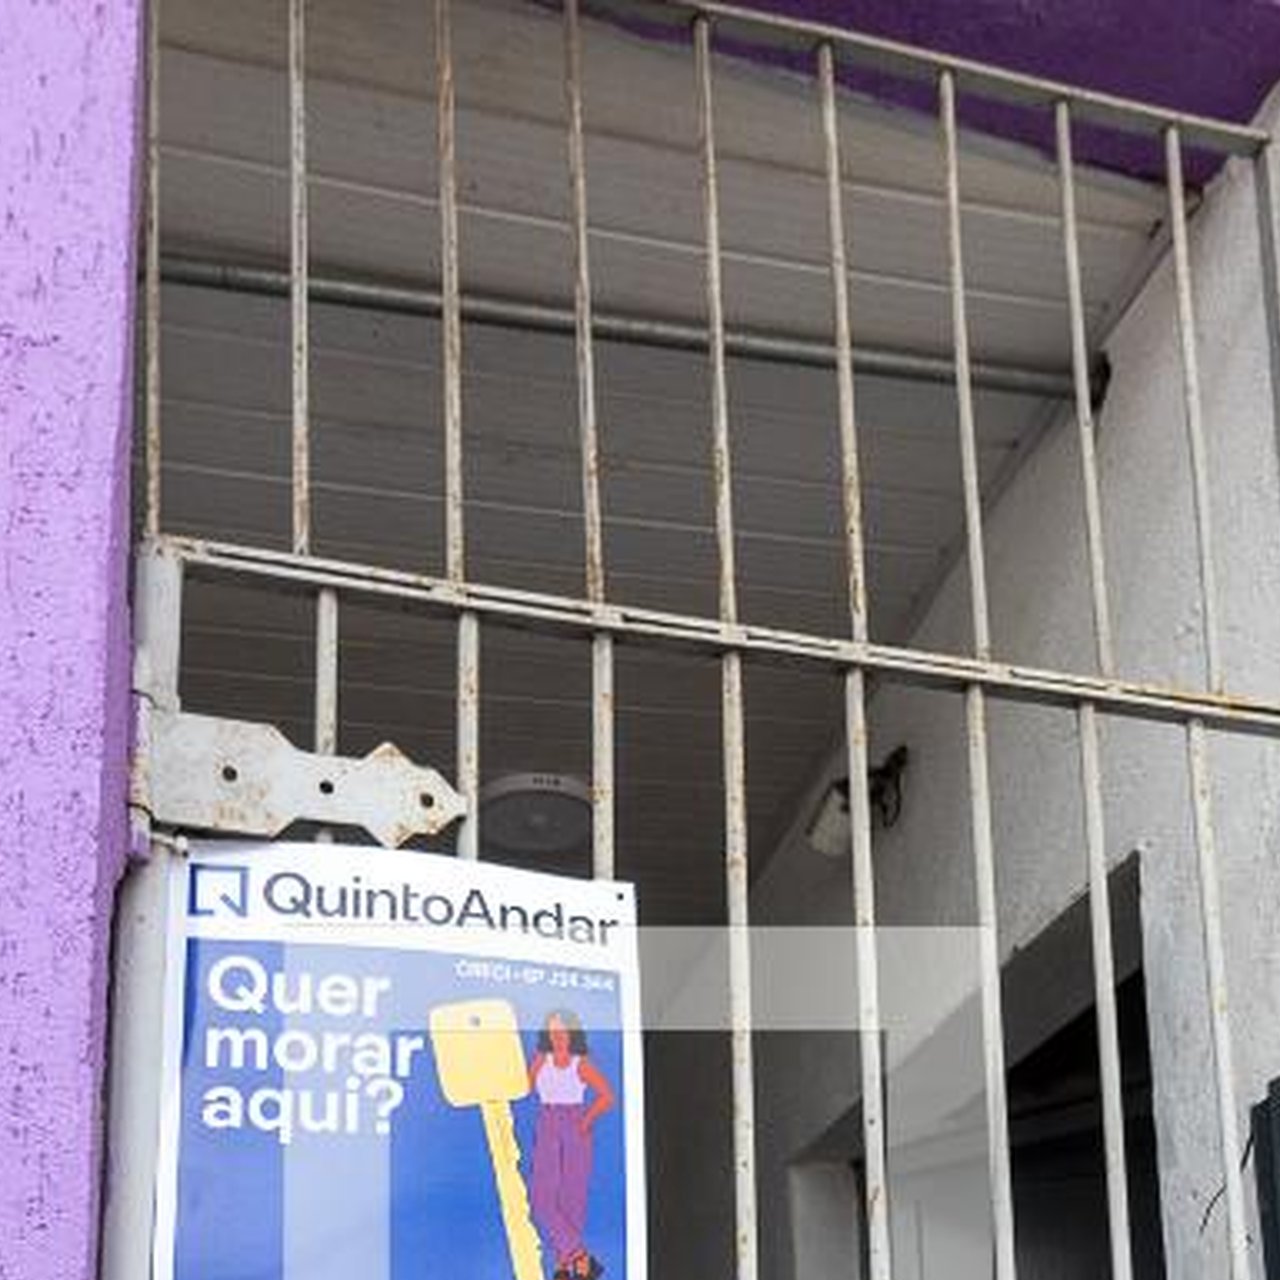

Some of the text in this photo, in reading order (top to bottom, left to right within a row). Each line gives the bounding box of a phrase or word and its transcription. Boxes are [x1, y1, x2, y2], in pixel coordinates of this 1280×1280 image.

[262, 870, 619, 947] QuintoAndar
[207, 955, 392, 1017] Quer
[204, 1027, 424, 1078] morar
[201, 1076, 404, 1146] aqui?
